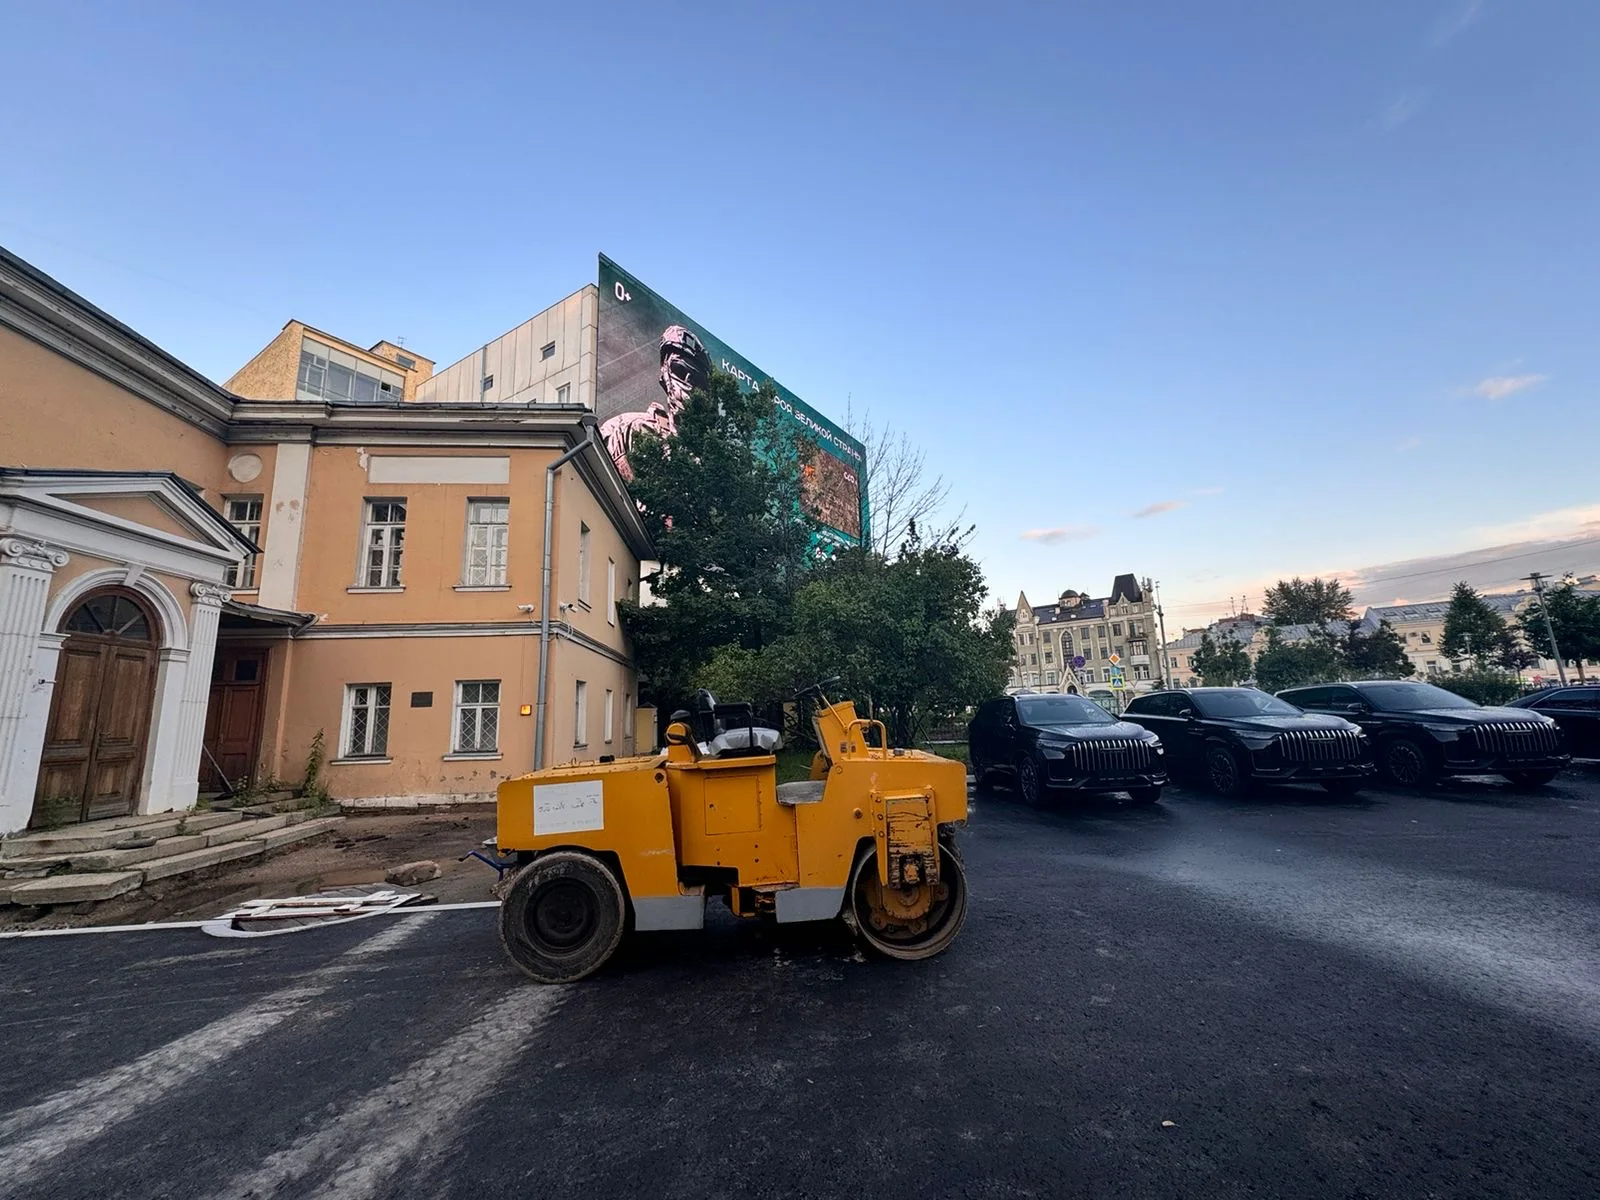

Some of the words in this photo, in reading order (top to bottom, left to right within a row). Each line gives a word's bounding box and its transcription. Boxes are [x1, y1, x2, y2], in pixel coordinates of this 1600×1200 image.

[614, 281, 632, 302] 0+
[721, 358, 760, 392] КАРТА
[772, 395, 793, 415] РОЯ
